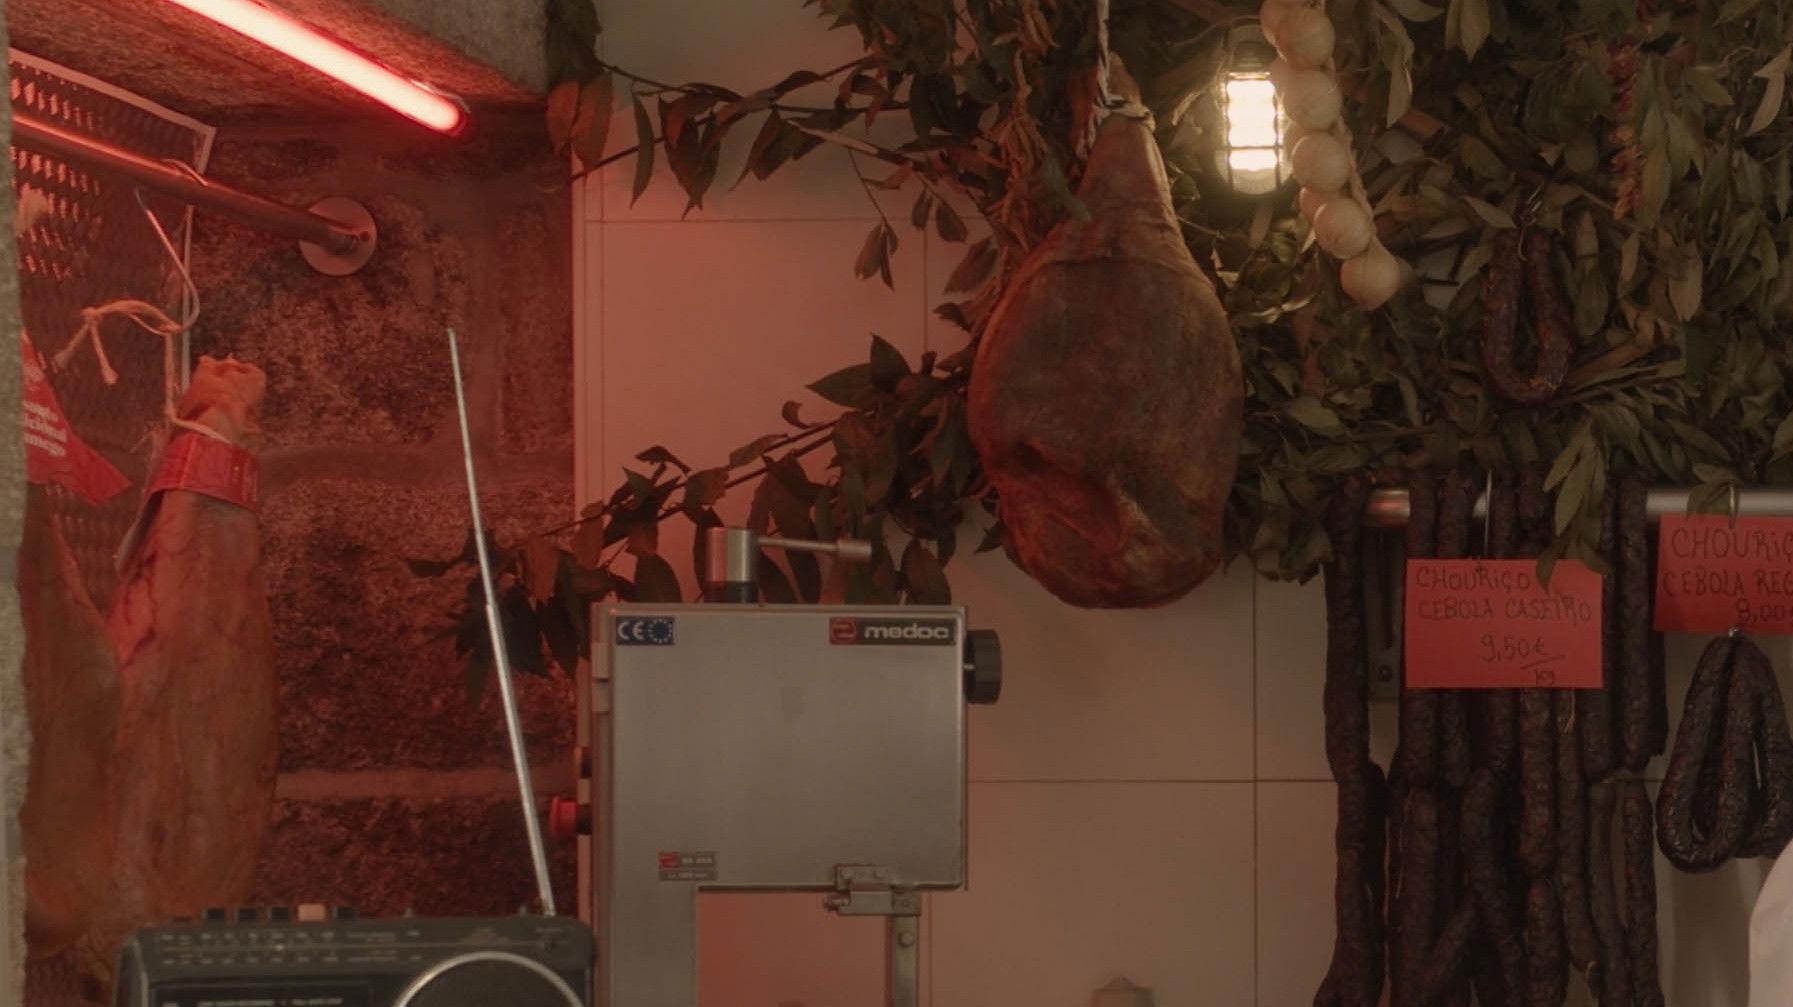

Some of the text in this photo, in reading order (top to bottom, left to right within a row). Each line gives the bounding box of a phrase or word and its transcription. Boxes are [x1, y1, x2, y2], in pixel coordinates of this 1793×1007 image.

[1662, 564, 1744, 598] CEBOLA
[1418, 596, 1494, 620] CEBOLA
[864, 621, 949, 640] medoc
